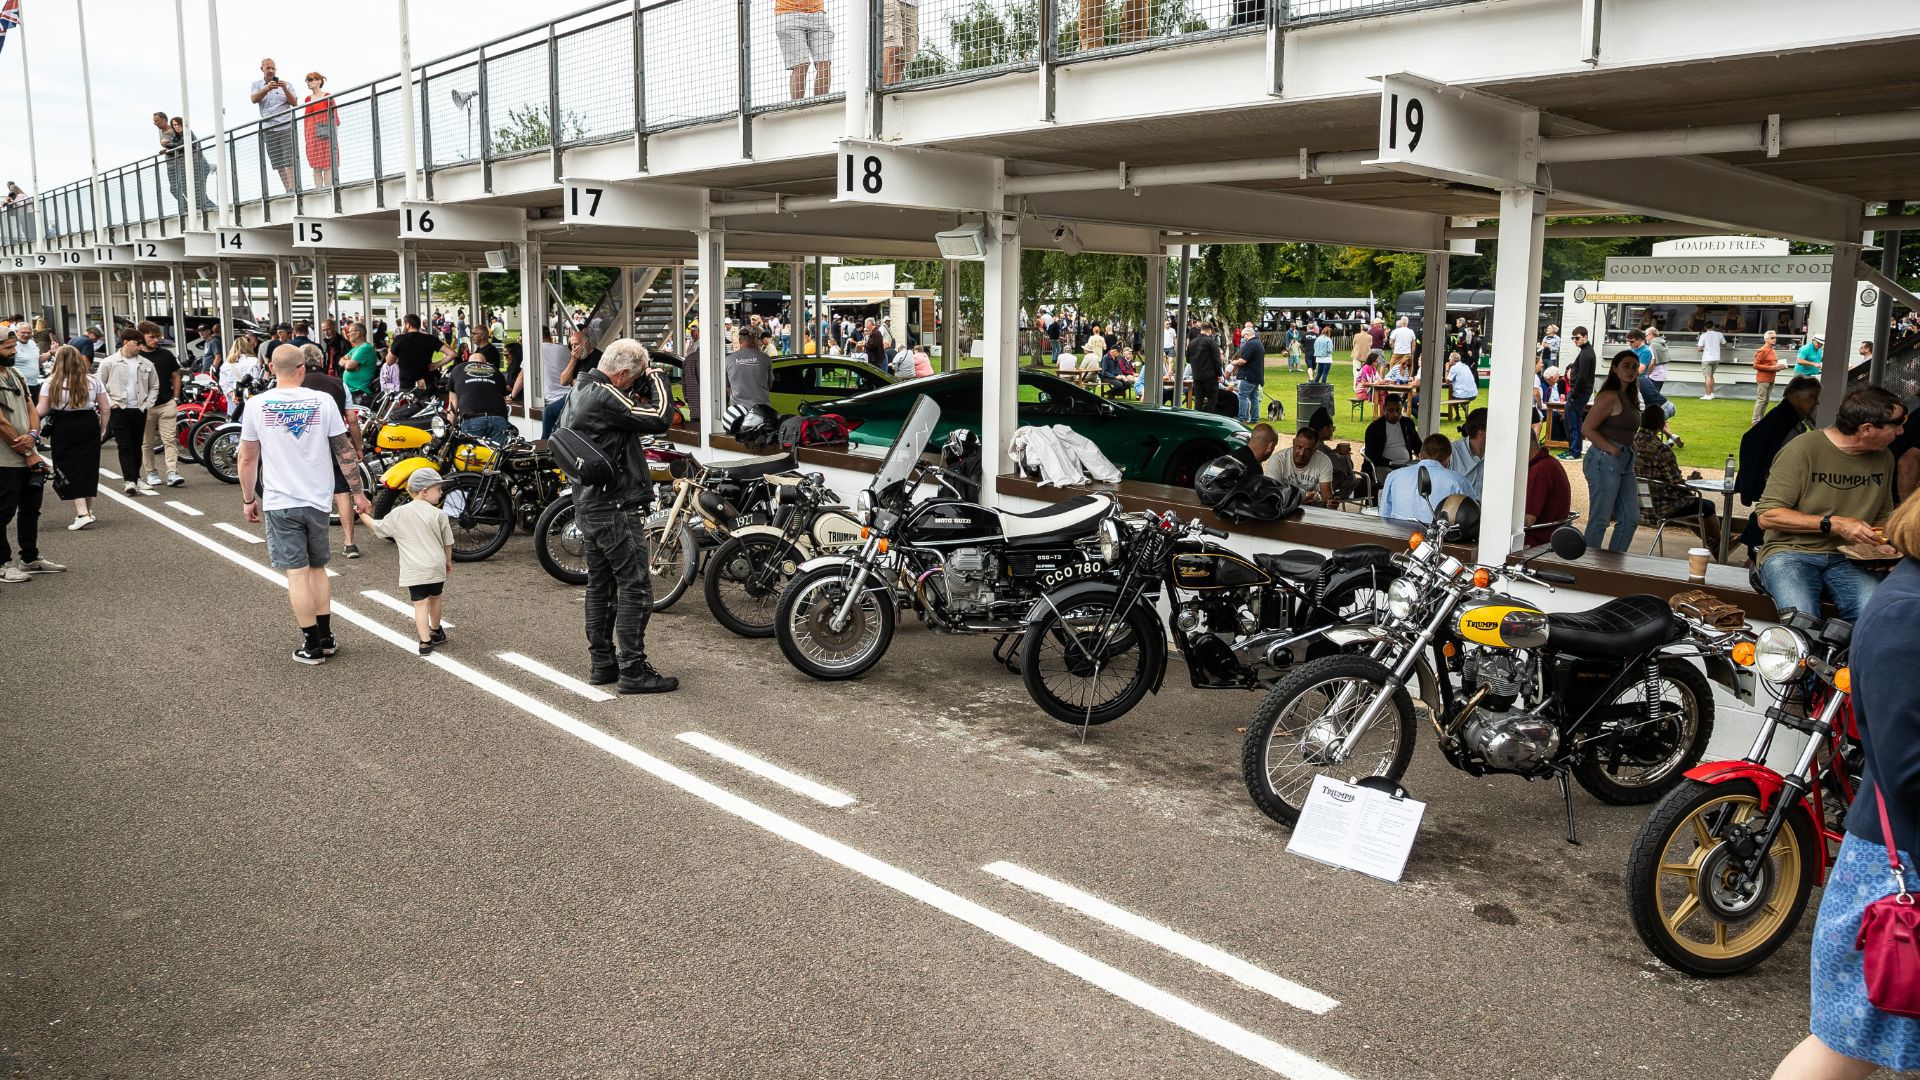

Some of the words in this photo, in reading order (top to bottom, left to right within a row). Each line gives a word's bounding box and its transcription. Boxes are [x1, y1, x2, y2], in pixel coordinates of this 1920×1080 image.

[1389, 93, 1424, 153] 19
[846, 154, 883, 194] 18
[571, 187, 603, 217] 17
[406, 209, 434, 233] 16
[299, 222, 323, 242] 15
[221, 232, 242, 249] 14
[1675, 241, 1725, 251] LOADED
[1729, 240, 1766, 250] FRIES
[97, 248, 113, 260] 11
[138, 243, 157, 257] 12
[15, 257, 23, 267] 8
[38, 255, 46, 265] 9
[64, 252, 80, 263] 10
[844, 271, 880, 281] OATOPIA
[1610, 264, 1700, 275] GOODWOOD
[1705, 264, 1780, 275] ORGANIC
[1786, 263, 1832, 274] FOOD
[273, 410, 310, 429] Racing
[1811, 472, 1871, 487] TRIUMPH
[735, 514, 753, 527] 1927
[828, 531, 858, 543] TRIUMPH
[1045, 566, 1073, 586] CCO
[1074, 562, 1101, 575] 780
[1466, 619, 1499, 630] TRIUMPH
[1322, 785, 1356, 802] TRIUMPH
